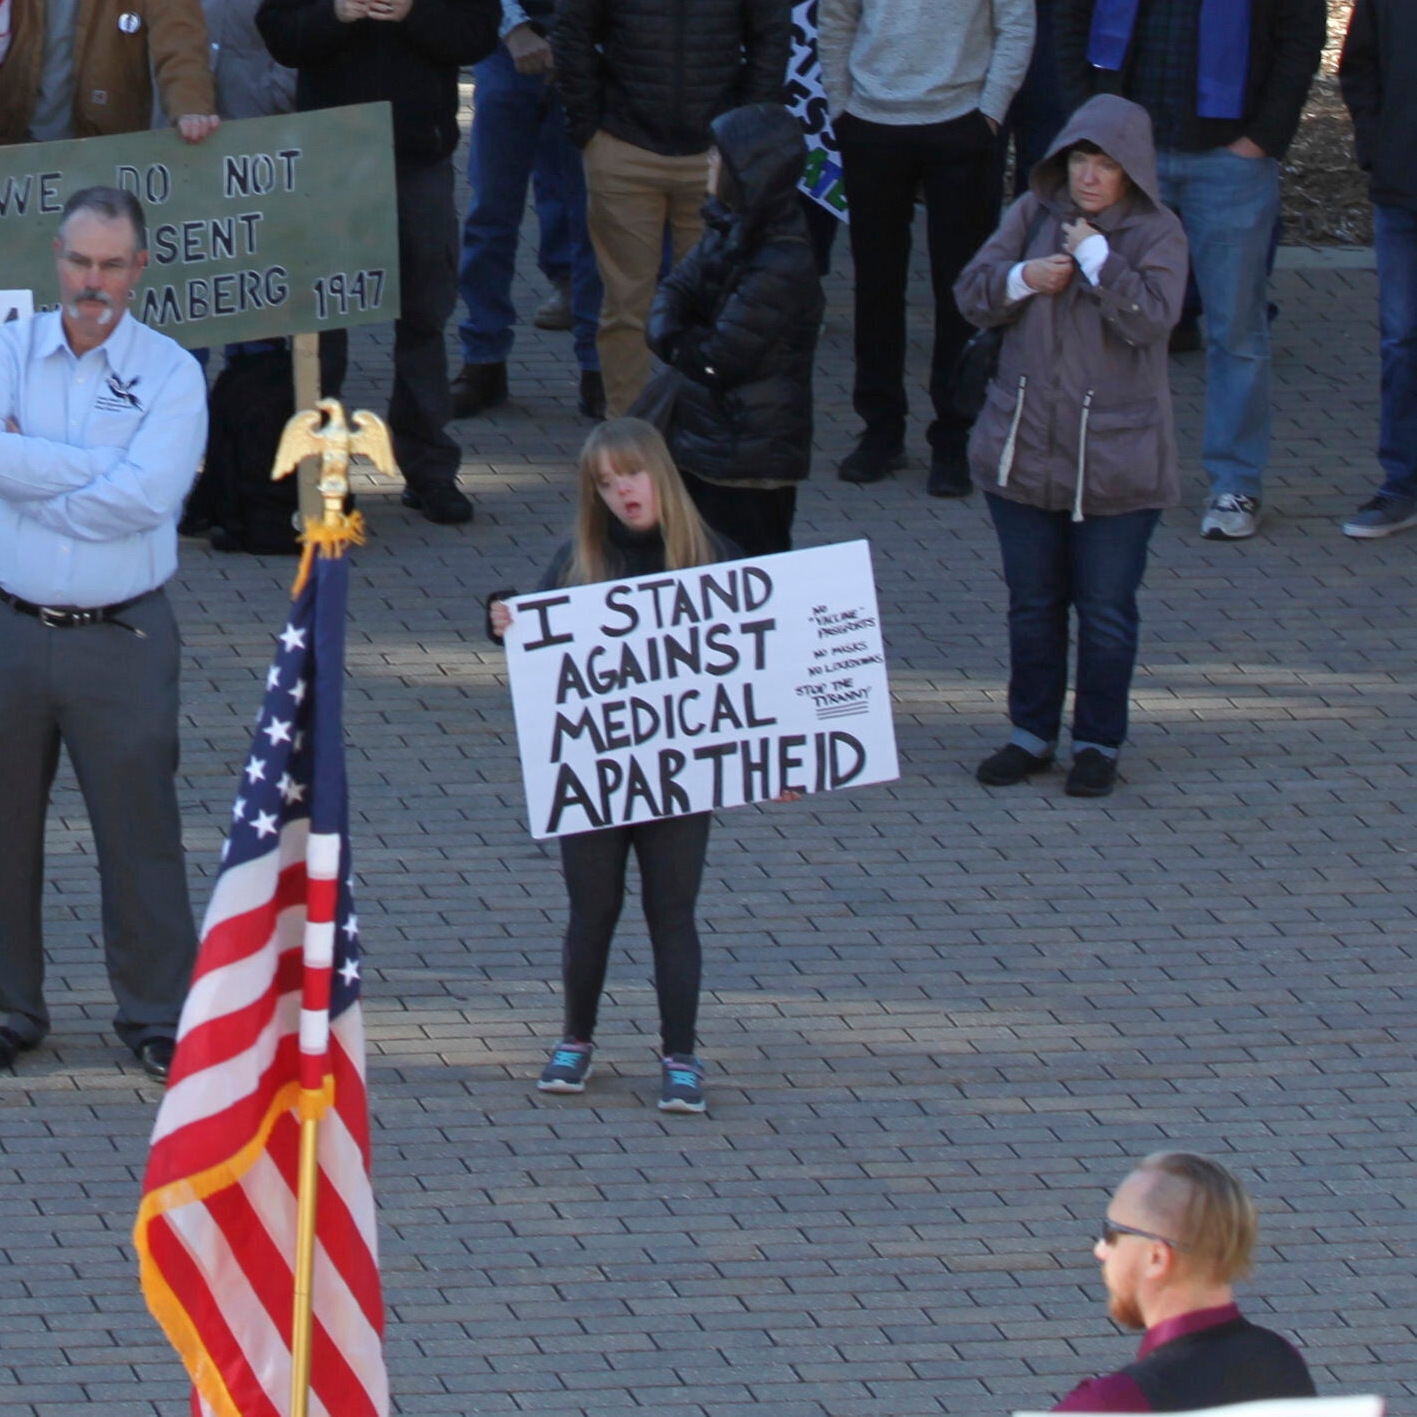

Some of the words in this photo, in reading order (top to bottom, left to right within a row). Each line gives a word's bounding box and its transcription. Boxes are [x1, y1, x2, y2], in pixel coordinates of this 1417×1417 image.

[117, 162, 171, 204] DO
[222, 148, 303, 199] NOT
[312, 268, 386, 320] 1947
[517, 595, 574, 652] I
[600, 565, 774, 638] STAND
[556, 619, 775, 705] AGAINST
[550, 683, 776, 764] MEDICAL
[545, 730, 866, 834] APARTHEID
